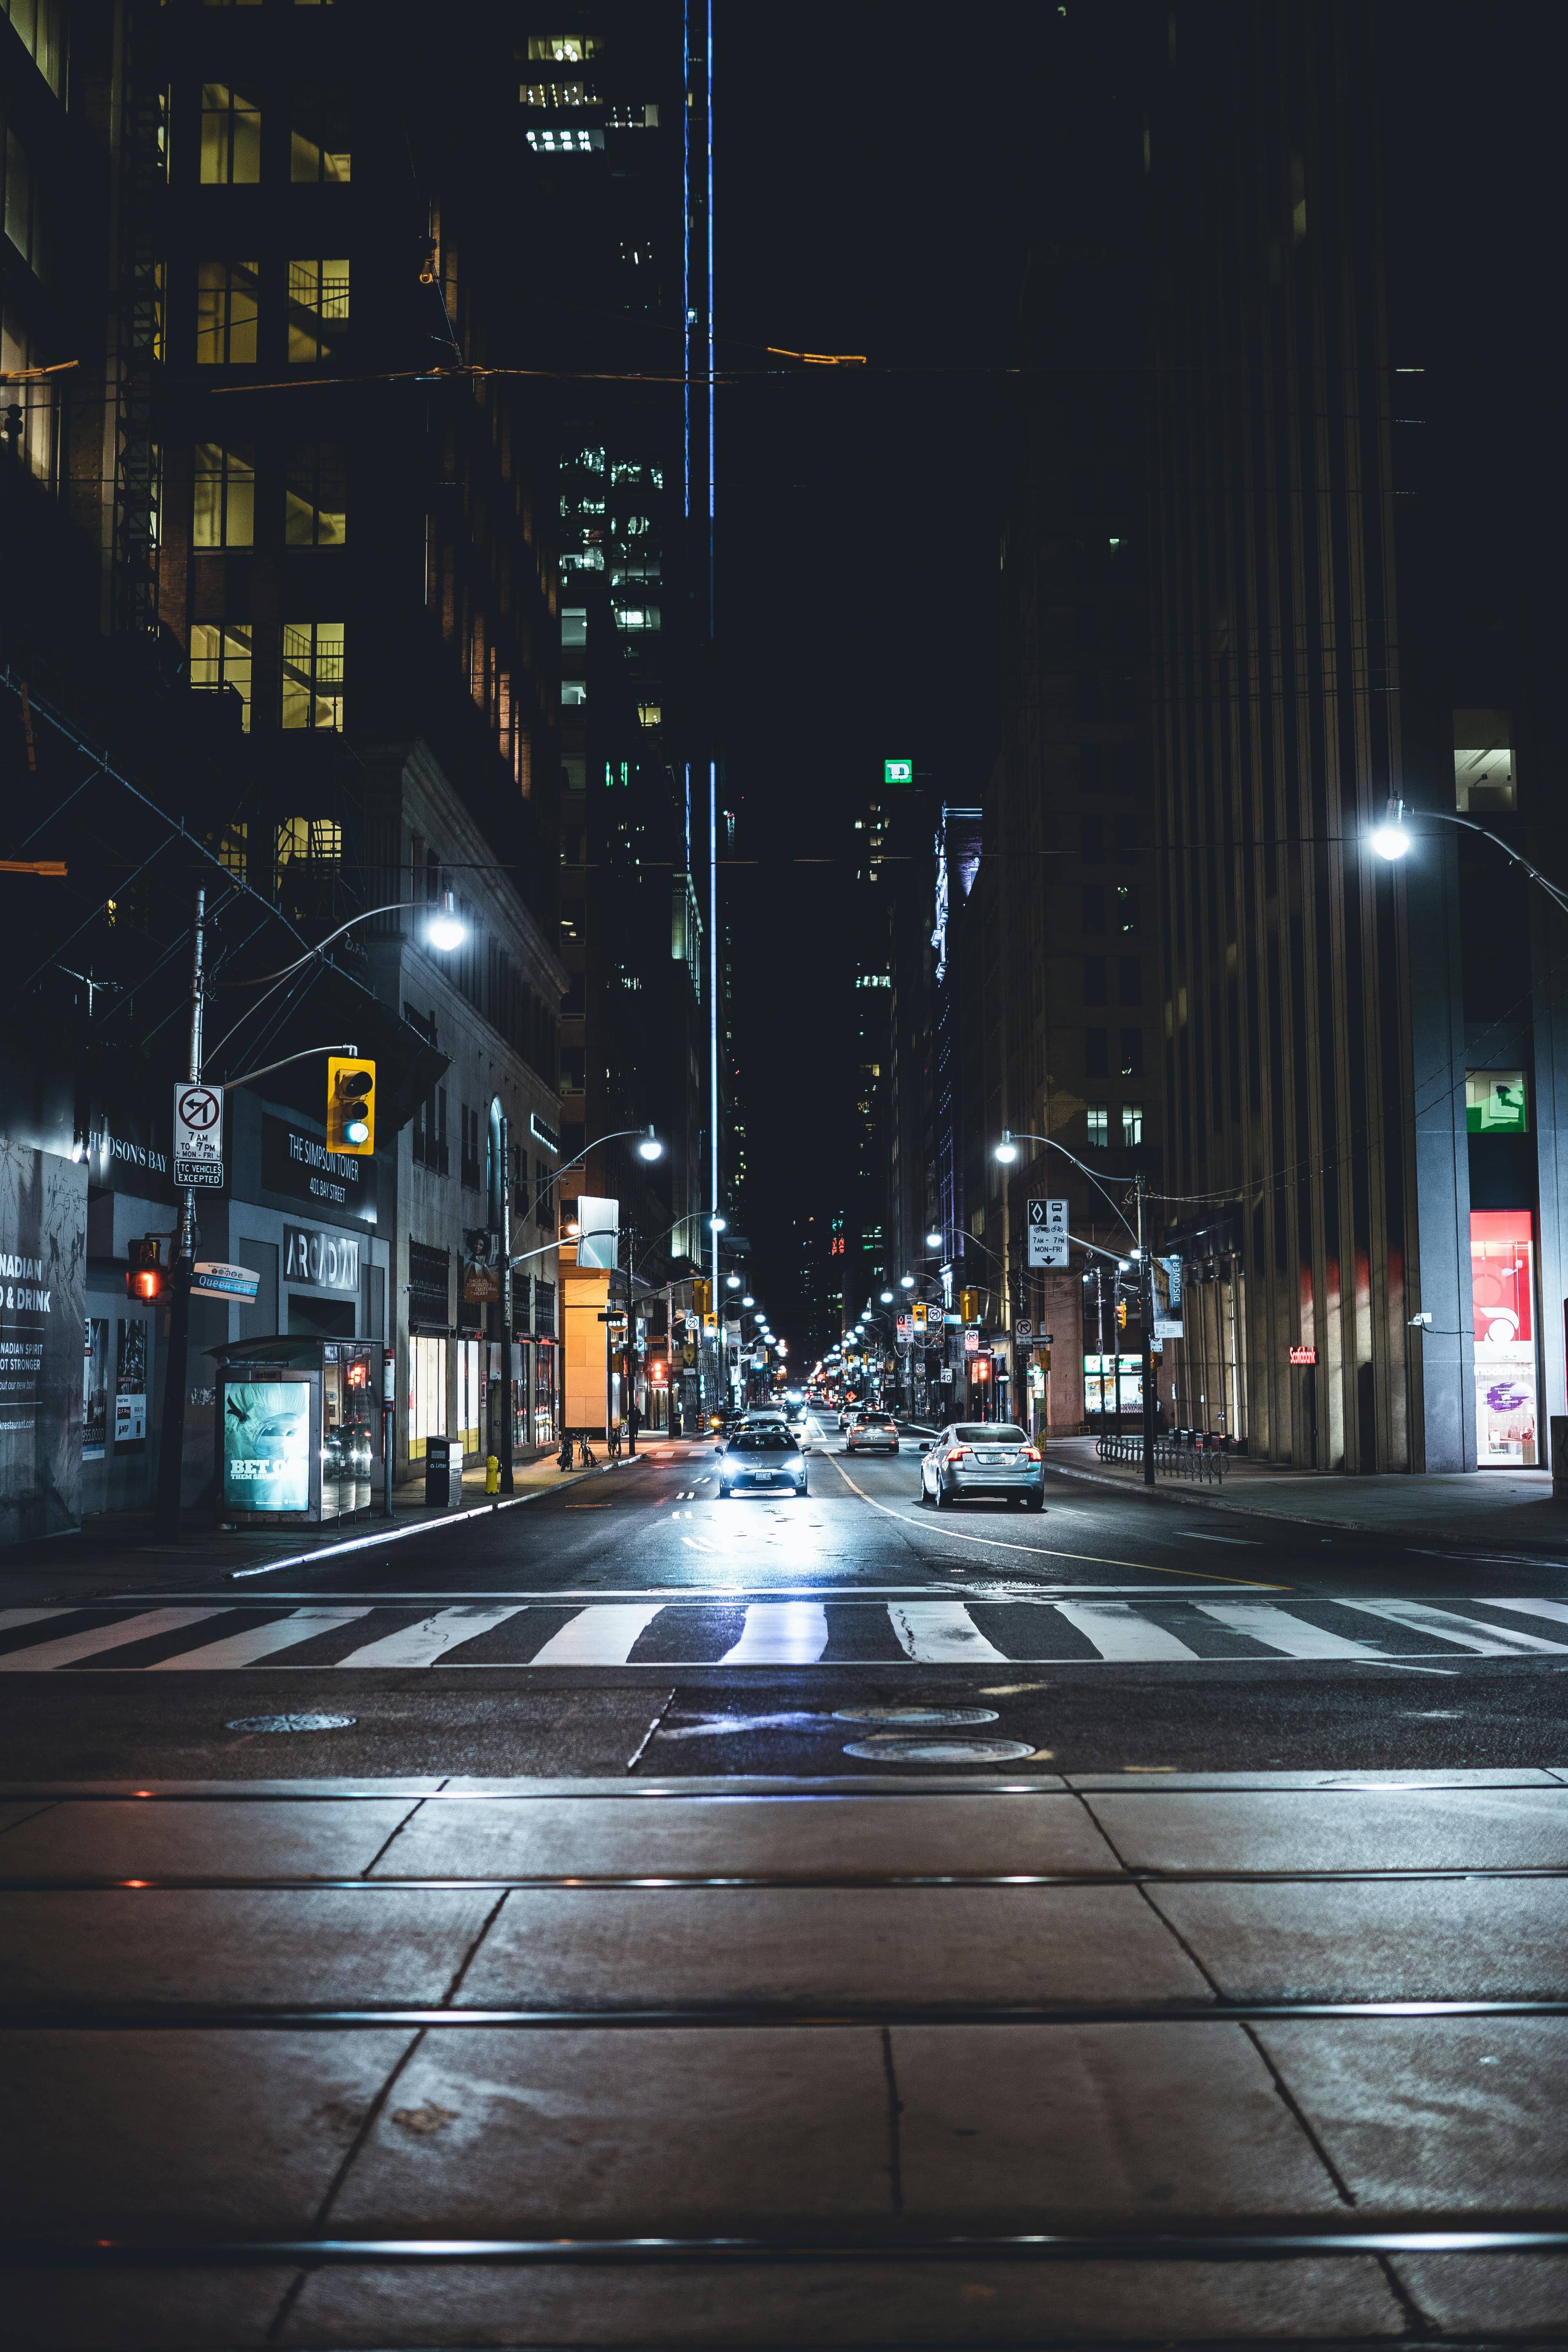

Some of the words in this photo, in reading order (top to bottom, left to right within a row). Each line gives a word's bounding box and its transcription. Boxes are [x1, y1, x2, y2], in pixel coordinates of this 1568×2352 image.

[887, 764, 909, 780] TD
[188, 1131, 194, 1140] 7
[89, 1131, 146, 1166] HUDSON'S
[148, 1150, 167, 1172] BAY
[197, 1142, 203, 1151] 7
[289, 1134, 303, 1161] THE
[305, 1140, 336, 1173] SIMPSON
[337, 1154, 359, 1182] TOWER
[176, 1164, 189, 1172] TTC
[192, 1165, 221, 1174] VEHICLES
[178, 1174, 219, 1183] EXCEPTED
[310, 1177, 319, 1195] 401
[320, 1180, 329, 1198] BAY
[330, 1184, 345, 1203] STREET
[199, 1276, 230, 1290] Queen
[7, 1286, 14, 1309] &
[17, 1287, 51, 1312] DRINK
[0, 1342, 24, 1355] NADIAN
[25, 1344, 43, 1355] SPIRIT
[1290, 1346, 1315, 1364] Scotiabank
[10, 1359, 40, 1370] STRONGER
[8, 1382, 16, 1390] our
[82, 1428, 104, 1441] 955.0000
[231, 1459, 270, 1474] BET
